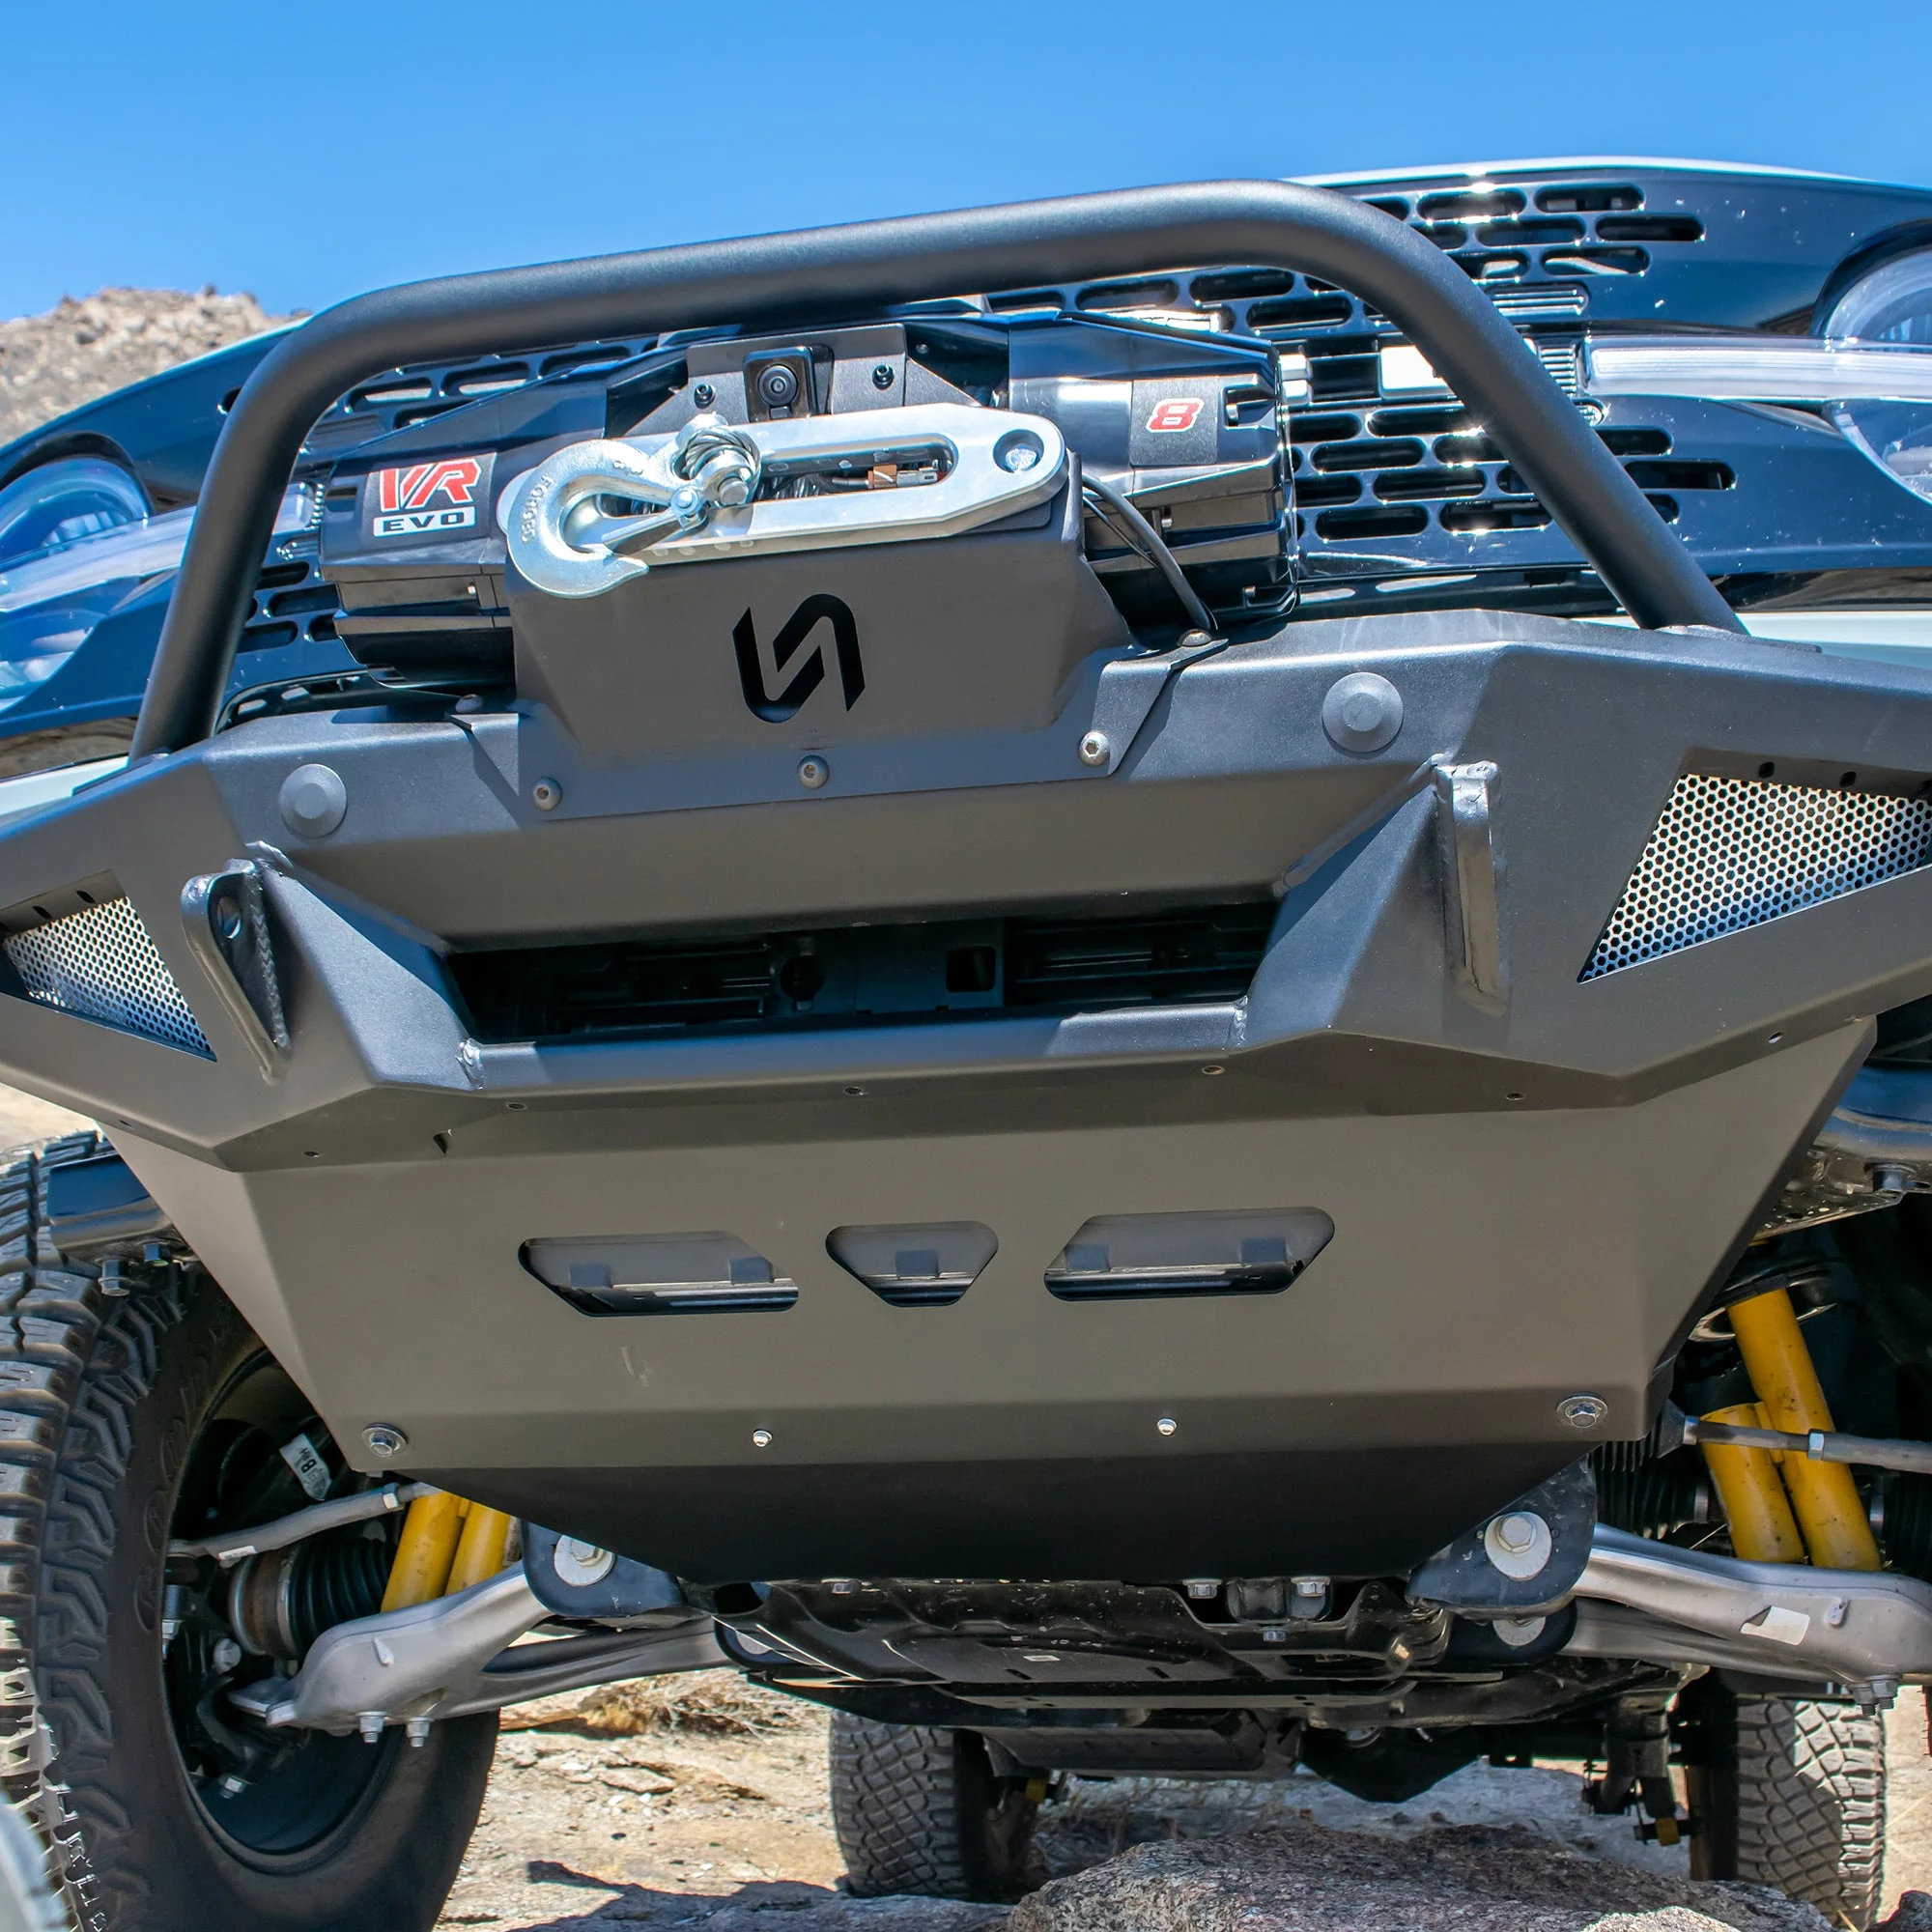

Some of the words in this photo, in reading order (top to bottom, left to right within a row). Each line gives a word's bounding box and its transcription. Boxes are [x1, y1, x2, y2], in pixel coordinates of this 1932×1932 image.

[1146, 398, 1205, 433] 8
[380, 459, 481, 513] VR
[382, 511, 465, 533] EVO
